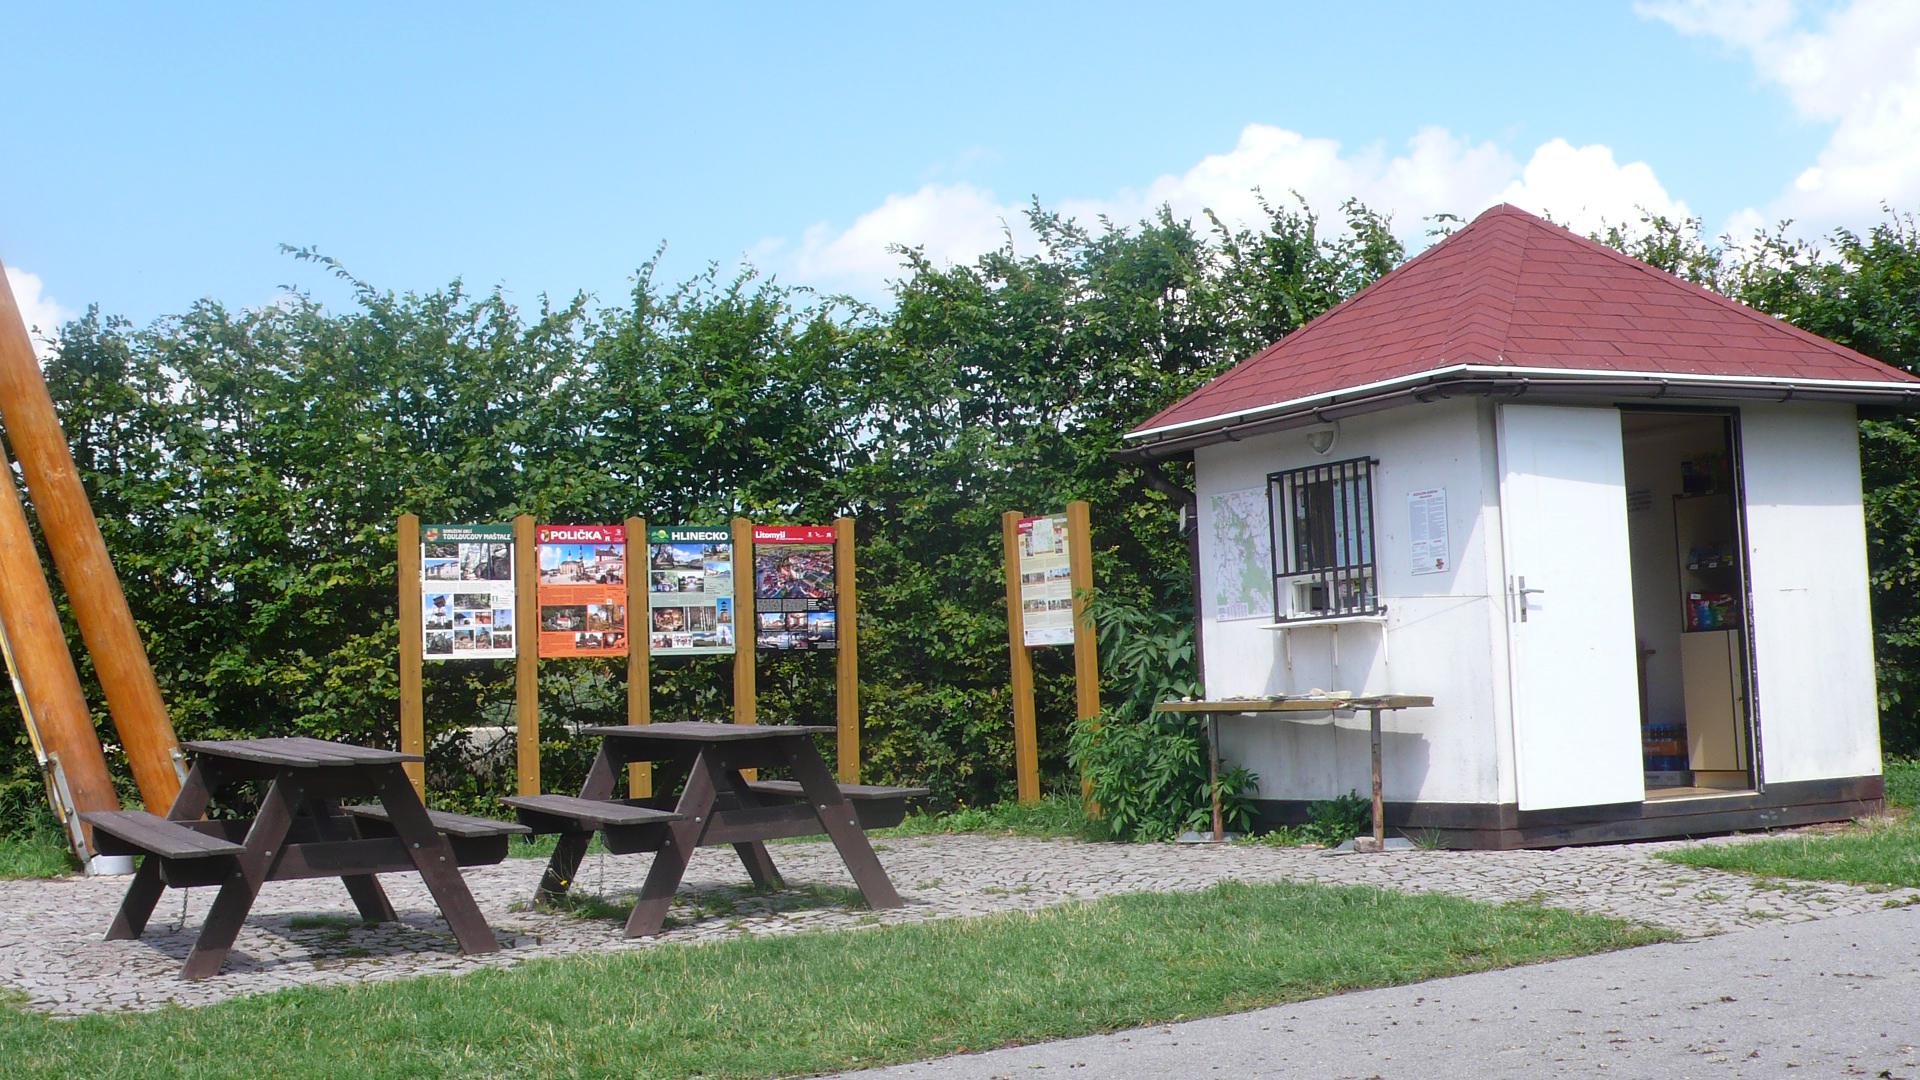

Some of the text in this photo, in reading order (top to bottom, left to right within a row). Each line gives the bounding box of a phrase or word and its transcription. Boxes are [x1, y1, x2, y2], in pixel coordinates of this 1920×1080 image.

[483, 532, 511, 540] MAŠTALE
[550, 529, 602, 540] POLIČKA
[671, 532, 728, 540] HLINECKO
